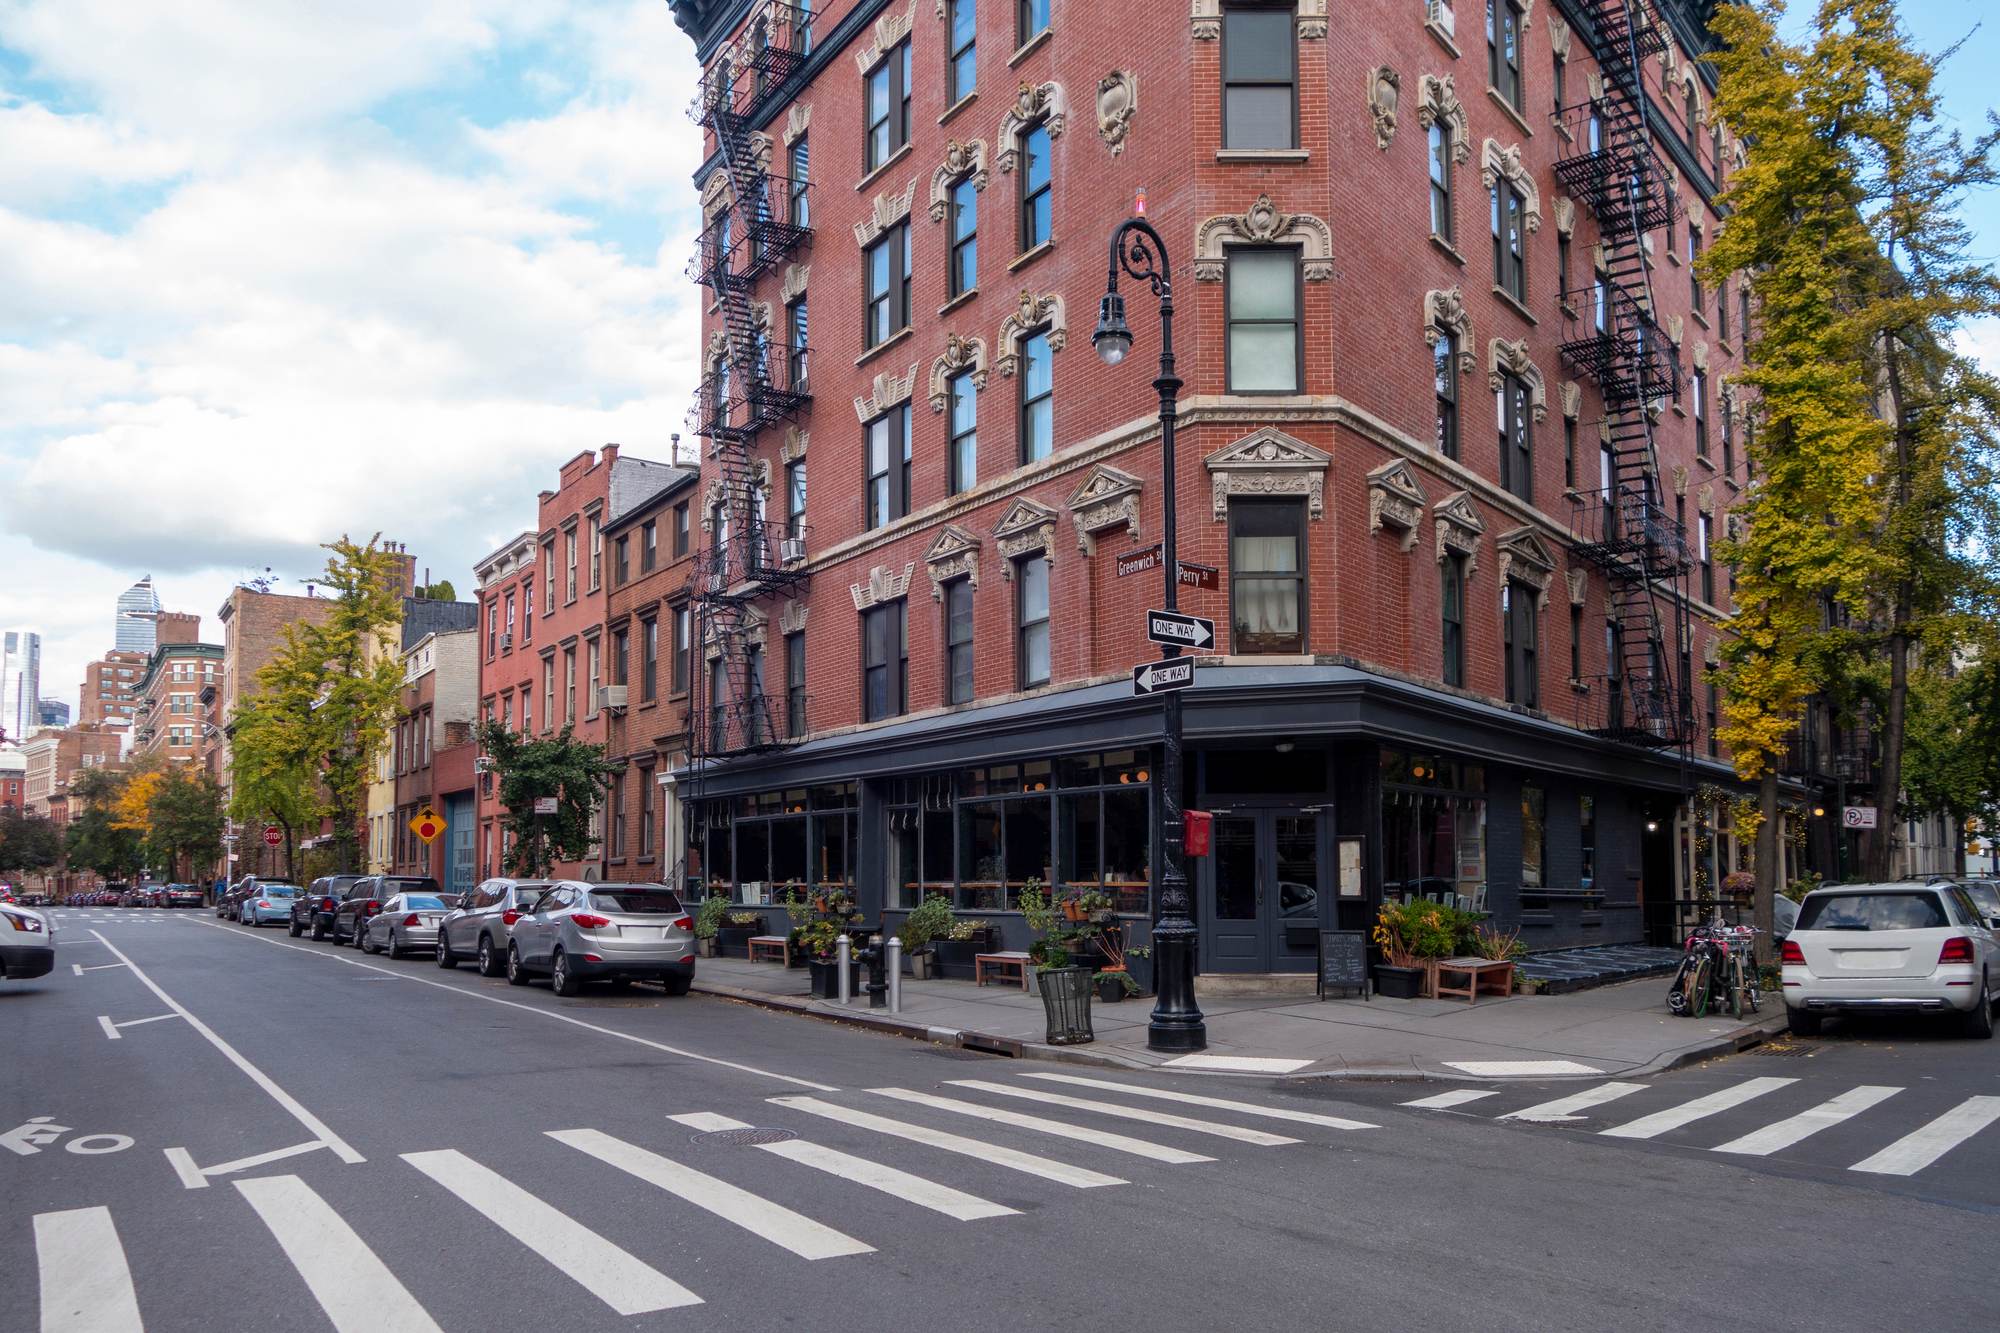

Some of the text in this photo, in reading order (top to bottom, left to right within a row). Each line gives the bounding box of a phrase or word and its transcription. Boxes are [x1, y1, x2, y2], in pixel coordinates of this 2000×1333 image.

[1118, 553, 1154, 576] Greenwich
[1178, 566, 1200, 587] Perry
[1202, 570, 1209, 581] St
[1155, 621, 1195, 638] ONE WAY
[1151, 666, 1188, 684] ONE WAY
